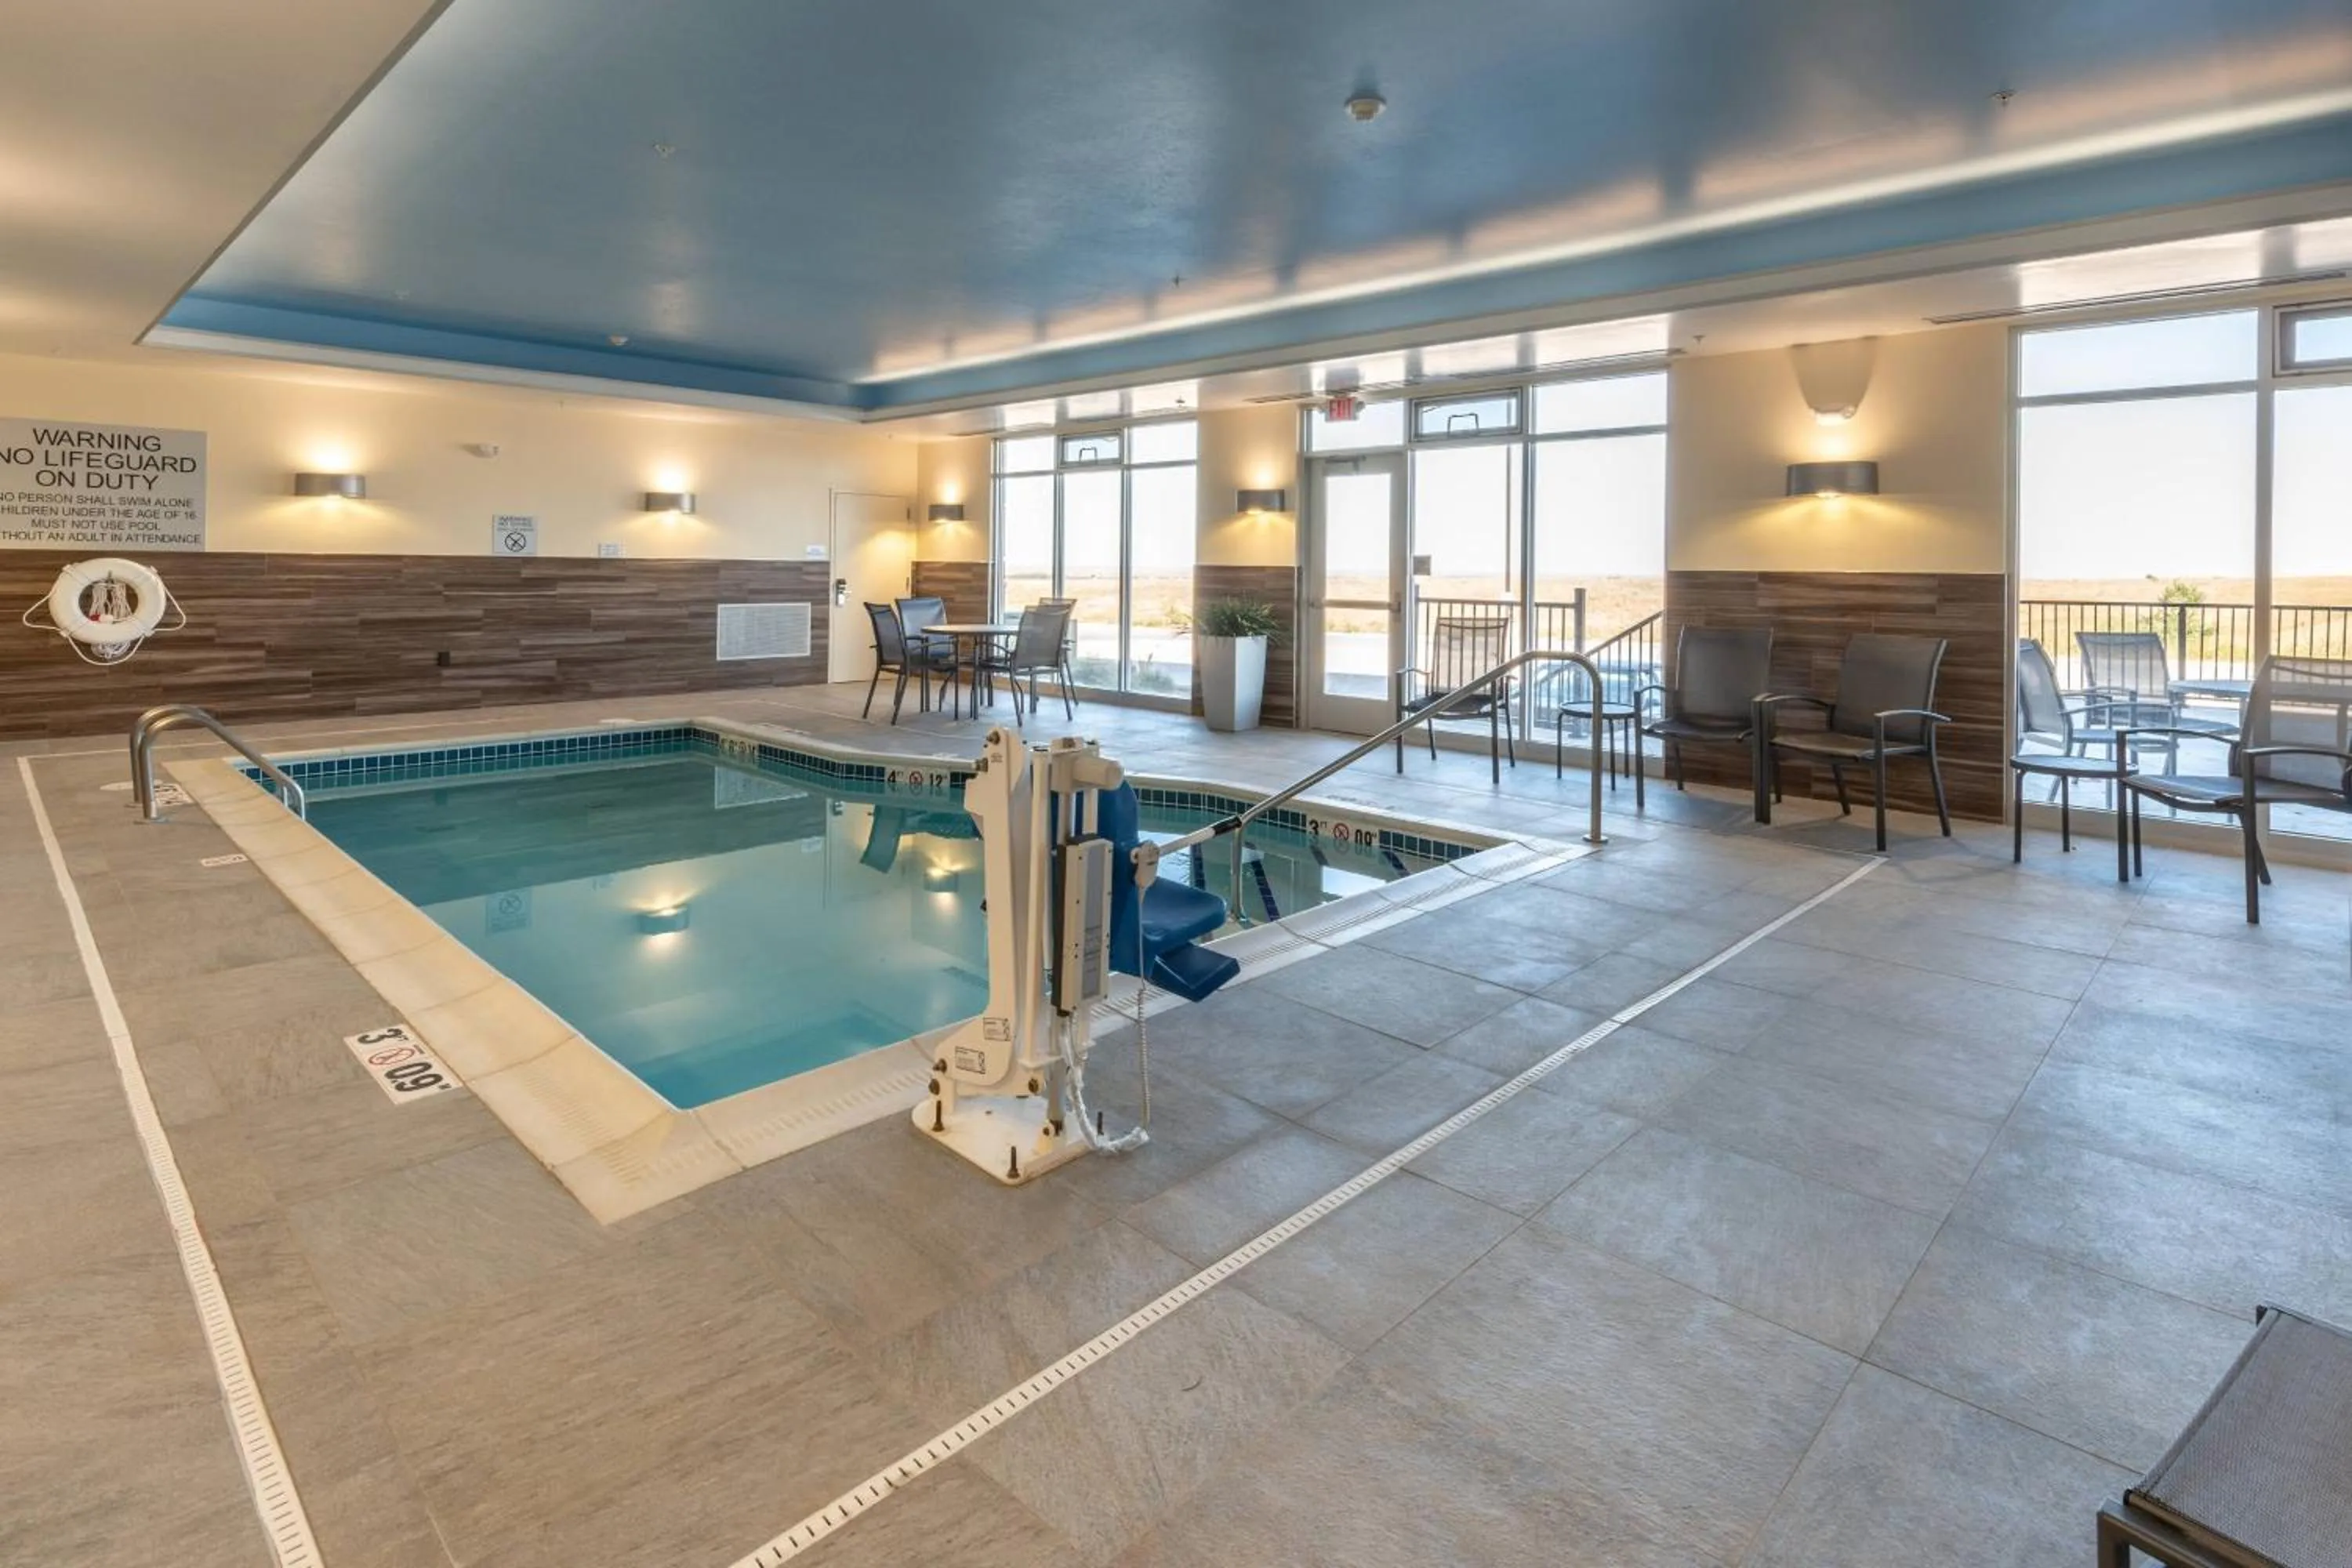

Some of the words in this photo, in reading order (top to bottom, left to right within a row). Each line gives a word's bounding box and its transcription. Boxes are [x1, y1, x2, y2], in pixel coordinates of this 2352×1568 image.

[32, 427, 162, 452] WARNING
[0, 447, 34, 465] NO
[45, 449, 197, 474] LIFEGUARD
[35, 470, 76, 488] ON
[86, 471, 159, 490] DUTY
[18, 492, 73, 504] PERSON
[77, 495, 114, 506] SHALL
[118, 496, 151, 507] SWIM
[154, 498, 194, 509] ALONE
[62, 506, 107, 517] UNDER
[111, 508, 133, 519] THE
[136, 509, 161, 520] AGE
[164, 510, 181, 520] OF
[31, 518, 67, 529] MUST
[71, 520, 97, 531] NOT
[100, 521, 126, 531] USE
[129, 521, 161, 532] POOL
[48, 532, 65, 542] AN
[68, 532, 107, 543] ADULT
[111, 533, 123, 543] IN
[125, 534, 201, 545] ATTENDANCE
